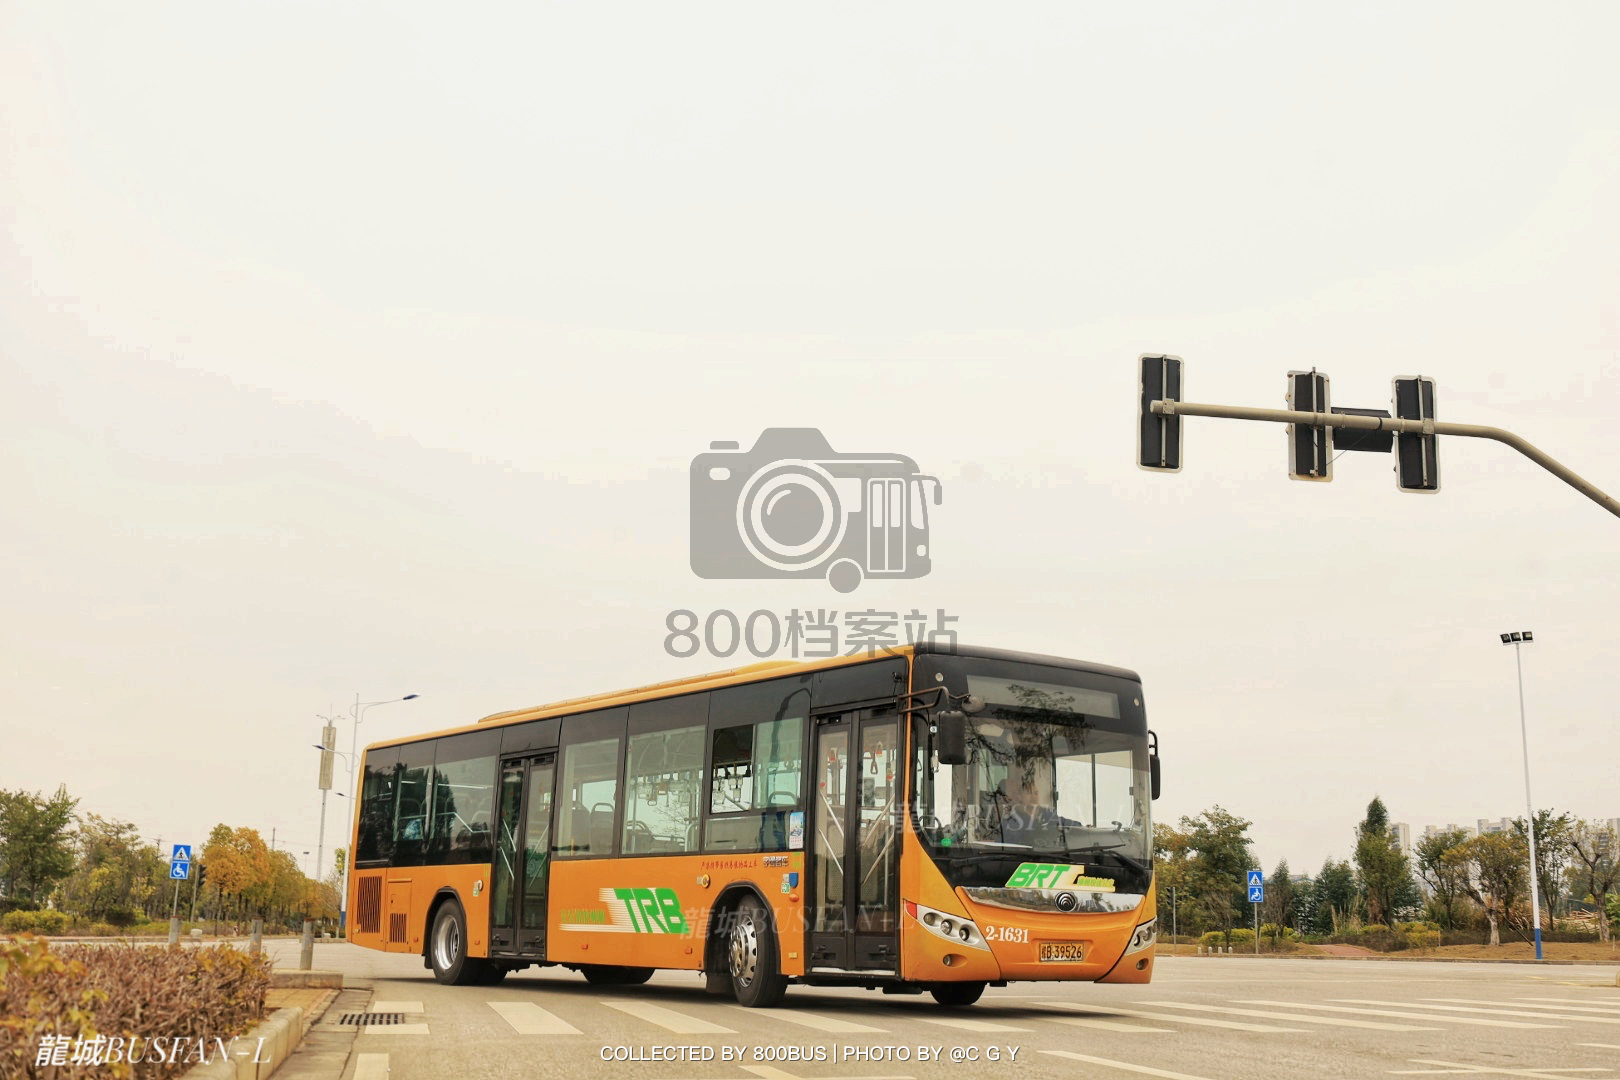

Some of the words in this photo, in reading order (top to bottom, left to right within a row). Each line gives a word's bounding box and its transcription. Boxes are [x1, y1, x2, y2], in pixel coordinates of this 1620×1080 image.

[1006, 863, 1071, 889] BRT
[612, 887, 690, 934] TRB
[985, 925, 1029, 943] 2-1631
